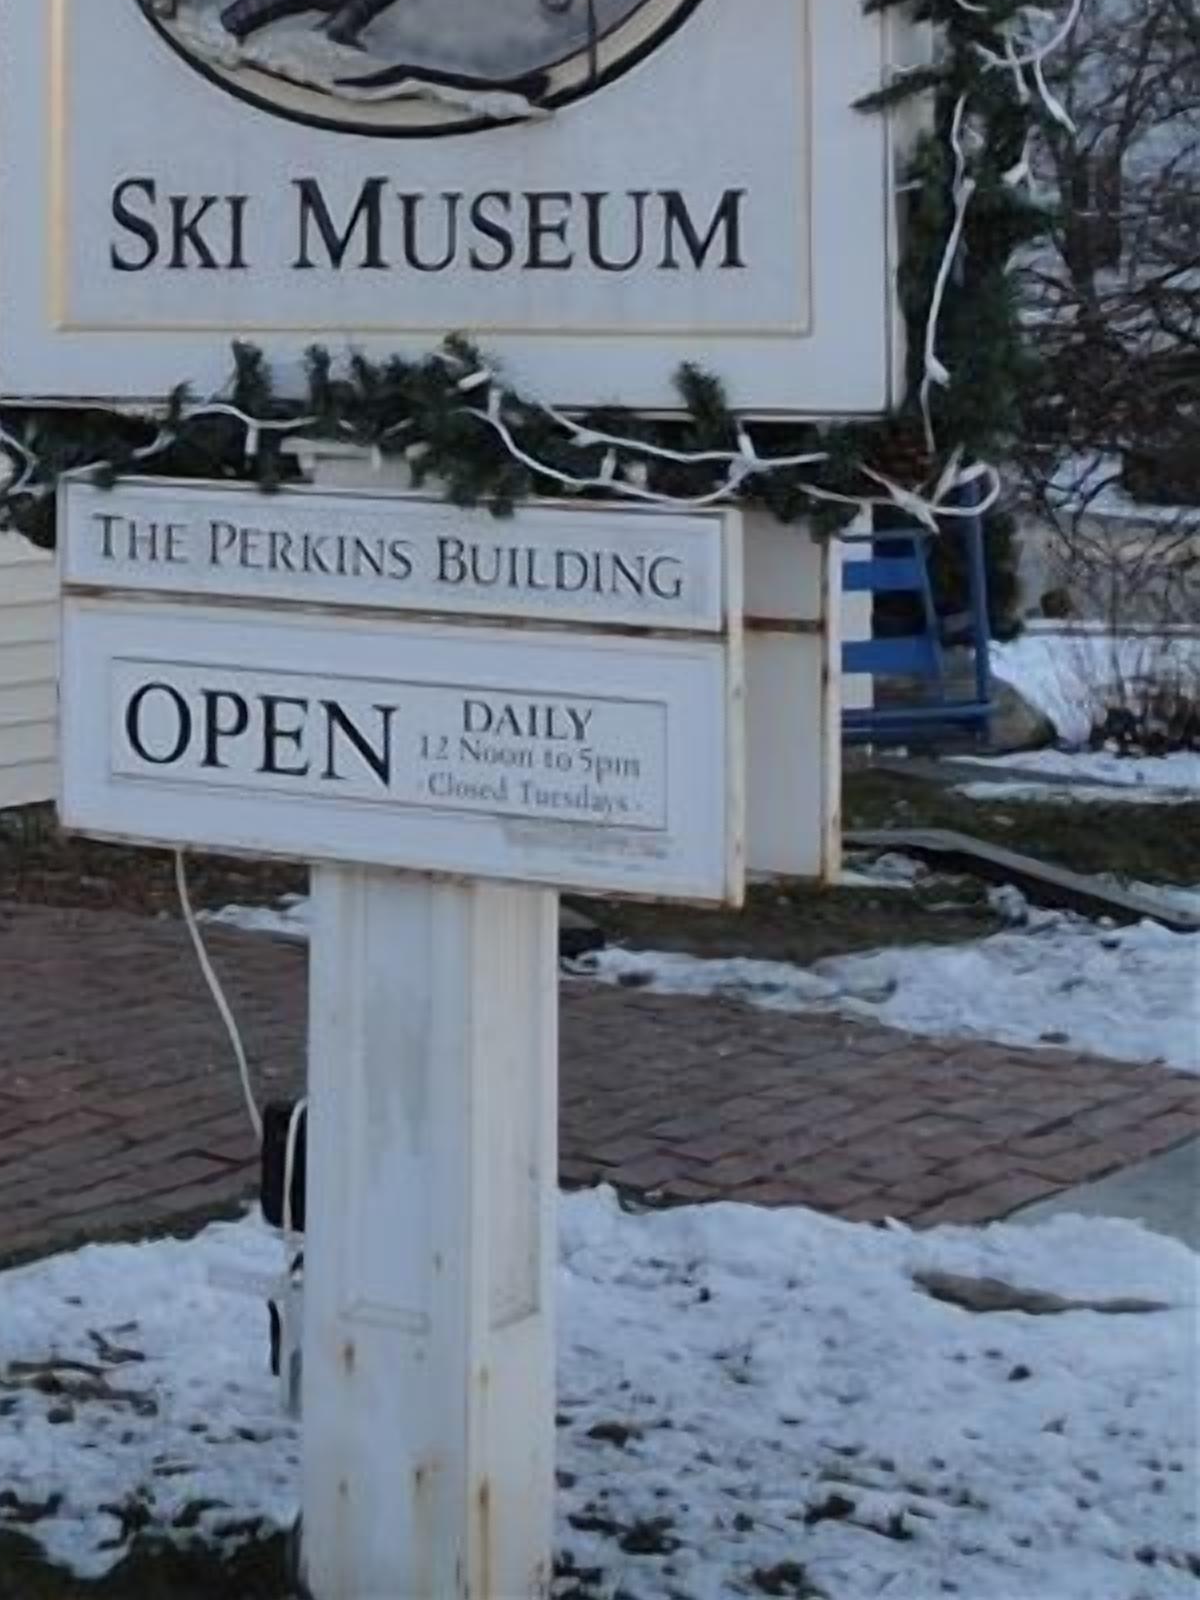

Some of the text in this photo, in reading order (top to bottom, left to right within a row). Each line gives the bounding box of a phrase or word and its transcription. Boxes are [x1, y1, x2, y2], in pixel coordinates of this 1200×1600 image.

[94, 513, 683, 599] THE PERKINS BUILDING
[125, 682, 398, 787] OPEN
[462, 699, 593, 741] DAILY
[419, 735, 641, 784] 12 Noon to 5pm
[428, 771, 508, 802] Closed
